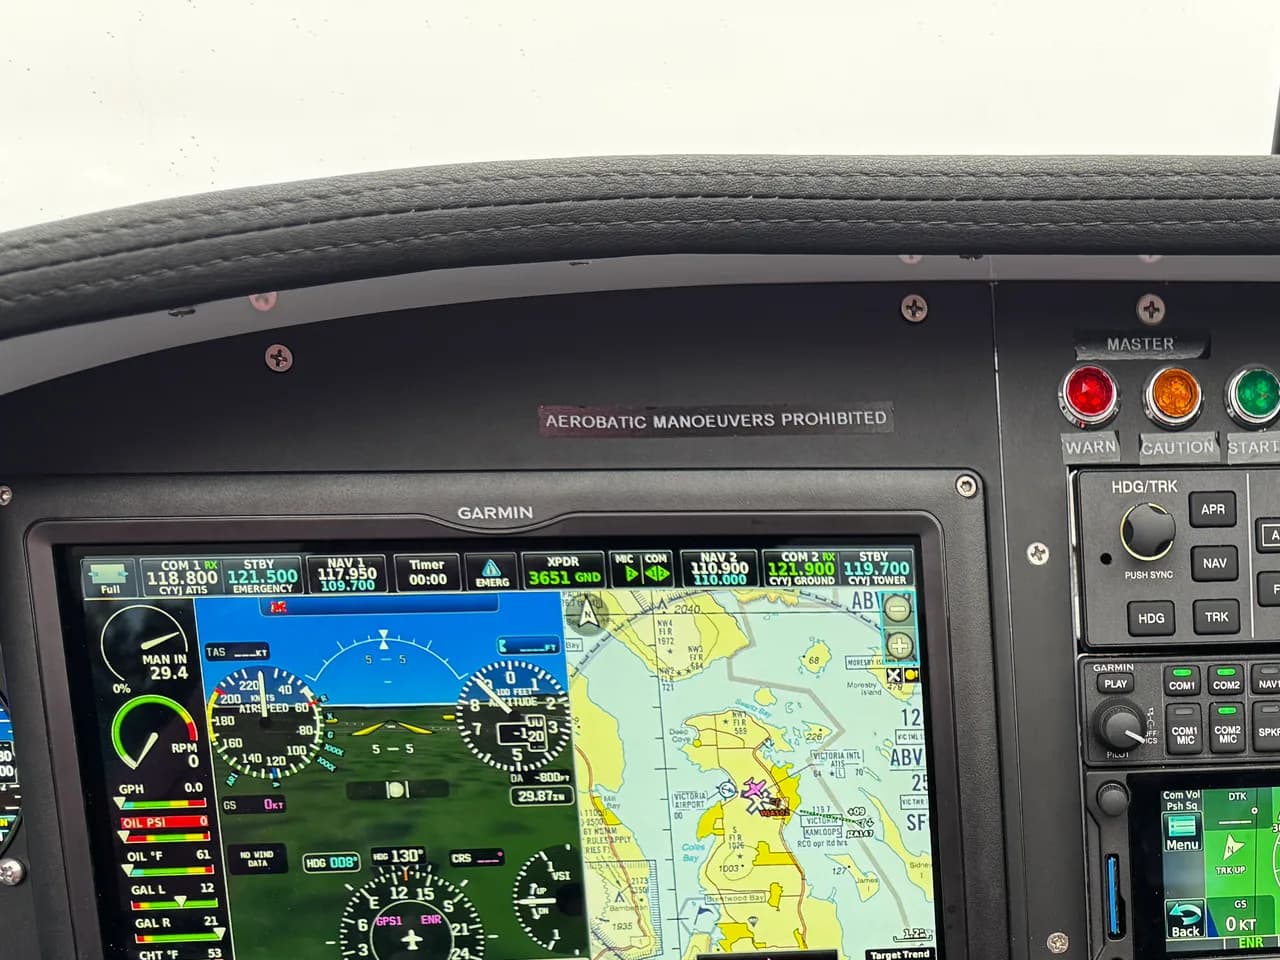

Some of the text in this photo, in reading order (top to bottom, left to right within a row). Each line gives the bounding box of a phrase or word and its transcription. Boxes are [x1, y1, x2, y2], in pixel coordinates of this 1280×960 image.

[1107, 336, 1175, 351] MASTER
[546, 410, 887, 430] AEROBATIC MANOEUVERS PROHIBITED
[1066, 439, 1116, 455] WARN
[1141, 438, 1215, 455] CAUTION
[1111, 480, 1178, 494] HDG/TRK
[458, 506, 533, 520] GARMIN
[1201, 503, 1226, 516] APR
[409, 559, 444, 571] Timer
[547, 556, 580, 568] XPDR
[1203, 557, 1227, 569] NAV
[318, 567, 377, 581] 117.950
[691, 562, 749, 575] 110.900
[768, 562, 835, 576] 121.900
[844, 561, 910, 576] 119.700
[147, 571, 218, 585] 118.800
[228, 570, 299, 584] 121.500
[409, 573, 447, 586] 00:00
[529, 571, 601, 585] 3651 GND
[769, 576, 835, 585] CYYJ GROUND
[1125, 570, 1174, 580] PUSH SYNC
[159, 585, 208, 595] CYYJ ATIS
[233, 584, 293, 594] EMERGENCY
[321, 580, 375, 592] 109.700
[1138, 612, 1165, 625] HDG
[1205, 611, 1229, 623] TRK
[149, 666, 189, 680] 29.4
[1093, 663, 1135, 672] GARMIN
[1105, 679, 1127, 689] PLAY
[1169, 681, 1195, 691] COM1
[1213, 680, 1240, 690] COM2
[1171, 727, 1198, 737] COM1
[1214, 726, 1241, 735] COM2
[1177, 735, 1195, 745] MIC
[1219, 733, 1238, 743] MIC
[1228, 792, 1247, 801] DTK
[1166, 839, 1199, 851] Menu
[1172, 925, 1200, 938] Back
[1239, 936, 1264, 949] ENR
